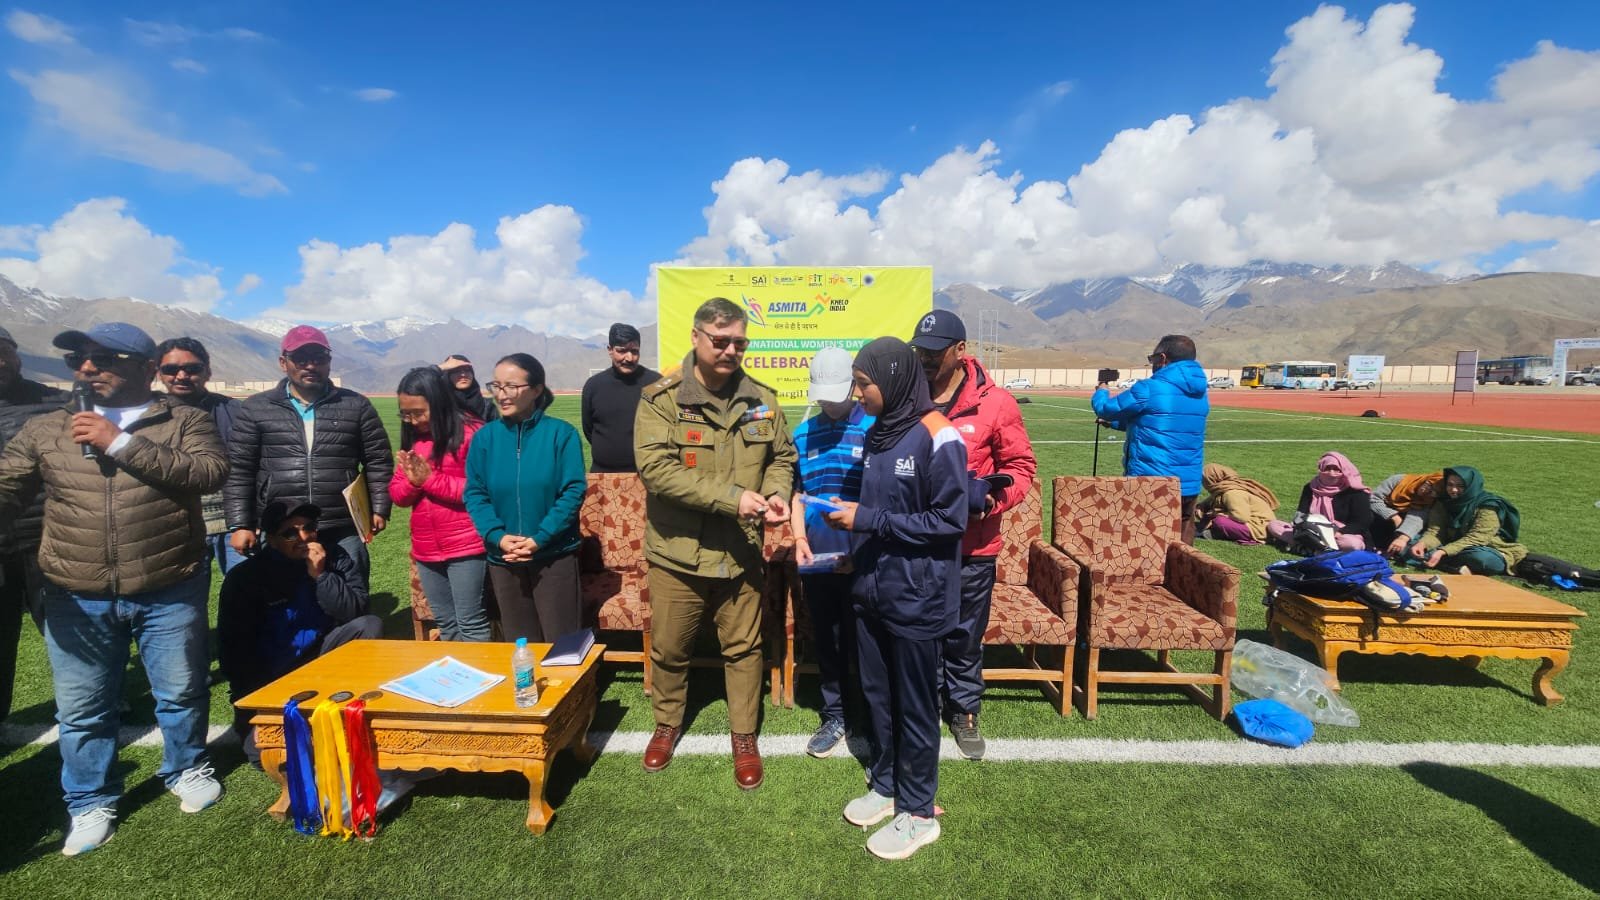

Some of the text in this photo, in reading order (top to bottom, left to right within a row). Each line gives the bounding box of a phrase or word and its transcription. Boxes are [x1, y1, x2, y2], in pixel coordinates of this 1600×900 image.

[768, 302, 807, 312] ASMITA
[801, 340, 844, 348] WOMEN'S
[846, 340, 864, 349] DAY
